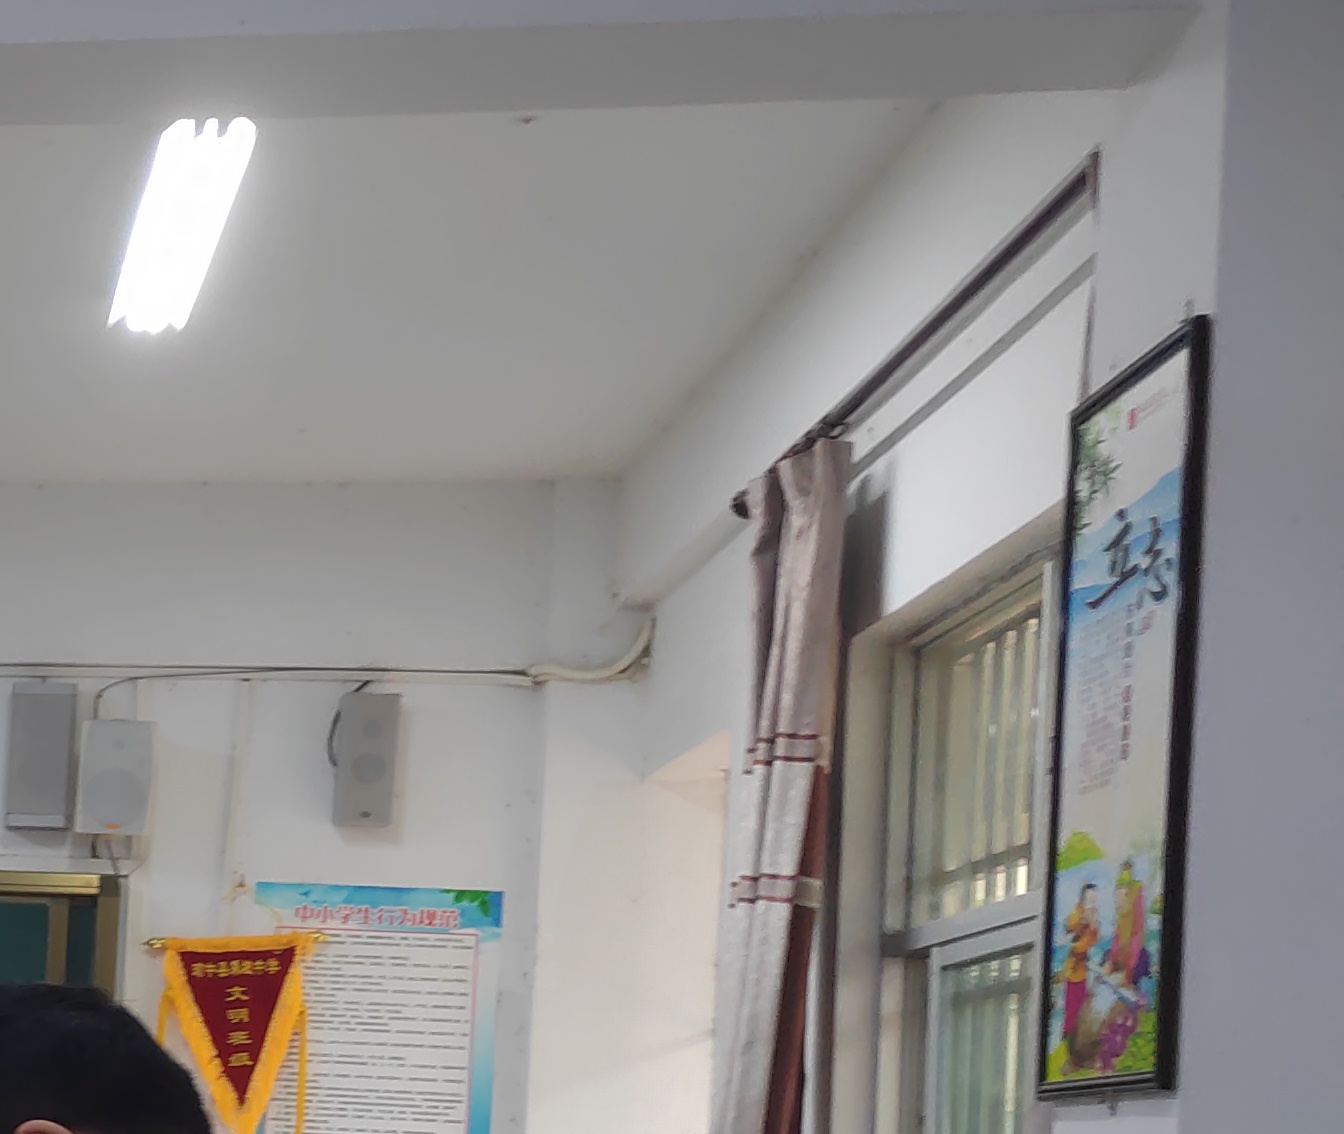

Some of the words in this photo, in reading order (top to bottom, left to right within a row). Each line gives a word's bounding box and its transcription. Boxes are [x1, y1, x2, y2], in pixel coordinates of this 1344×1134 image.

[294, 903, 460, 928] 中小学生行为规范
